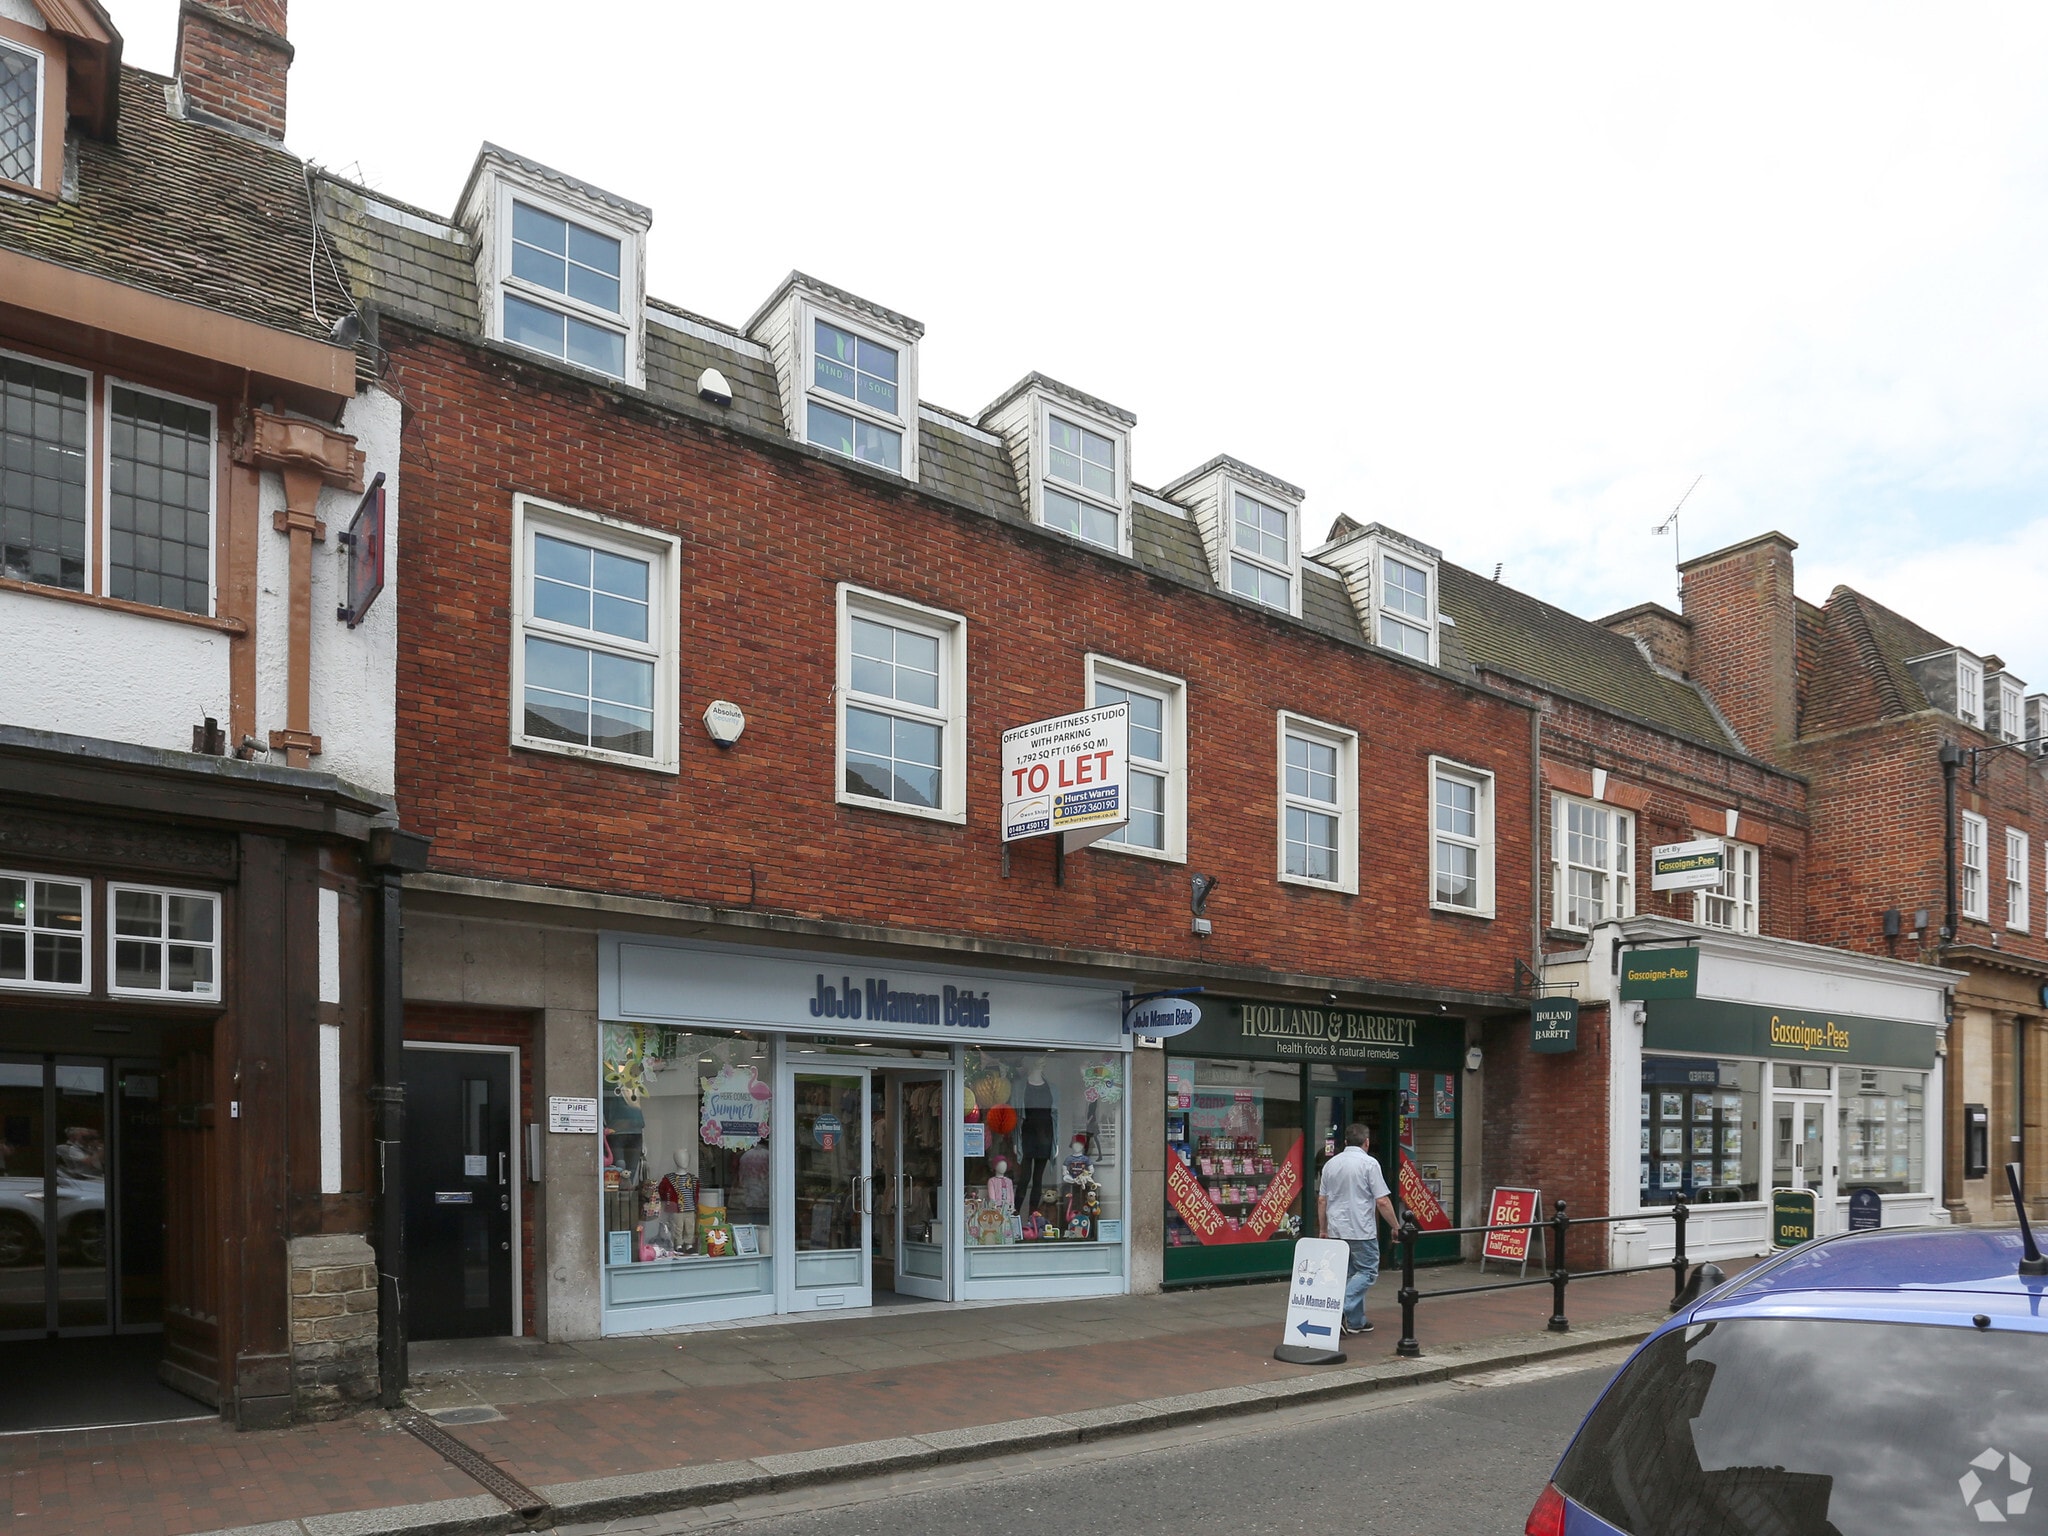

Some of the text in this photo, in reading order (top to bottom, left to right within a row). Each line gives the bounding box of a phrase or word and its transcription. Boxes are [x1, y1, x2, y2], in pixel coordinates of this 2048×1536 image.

[818, 363, 842, 378] MIND
[869, 382, 892, 398] SOUL
[713, 708, 741, 718] Absolute
[1004, 709, 1125, 743] OFFICE SUITE/FITNESS STUDIO
[1031, 728, 1091, 748] WITH PARKING
[1017, 738, 1108, 765] 1,792 SQ FT (166 SQ M)
[1012, 750, 1113, 796] TO LET
[1065, 789, 1115, 803] Hurst Warne
[1065, 800, 1115, 815] 01372 360190
[1055, 811, 1116, 824] www.hurstwarne.co.uk
[1009, 825, 1025, 833] 01483
[1026, 820, 1048, 829] 450115
[1672, 846, 1681, 854] By
[1659, 856, 1715, 870] Gascoigne-Pees
[1628, 967, 1688, 981] Gascoigne-Pees
[810, 974, 990, 1028] JoJo Maman Bébé
[1134, 1008, 1192, 1028] JoJo Maman Bébé
[1536, 1011, 1571, 1021] HOLLAND
[1241, 1005, 1416, 1047] HOLLAND & BARRETT
[1549, 1021, 1557, 1029] &
[1771, 1015, 1850, 1051] Gascoigne-Pees
[1535, 1030, 1570, 1040] BARRETT
[1277, 1041, 1399, 1059] health foods & natural remedies
[710, 1094, 753, 1120] Summer
[1194, 1094, 1226, 1109] Penny
[1192, 1111, 1216, 1127] Sale
[1175, 1162, 1224, 1227] better than half price
[1247, 1161, 1293, 1228] better than half price
[1253, 1170, 1296, 1236] BIG DEALS
[1399, 1168, 1434, 1222] BIG DEALS
[1168, 1172, 1217, 1235] BIG DEALS
[1273, 1193, 1293, 1225] NOW ON!
[1175, 1200, 1200, 1232] NOW ON!
[1496, 1206, 1521, 1223] BIG
[1490, 1232, 1510, 1241] better
[1781, 1225, 1808, 1238] OPEN
[1489, 1240, 1523, 1256] half price
[1292, 1294, 1305, 1305] JoJo
[1305, 1295, 1326, 1307] Maman
[1327, 1297, 1340, 1310] Bébé
